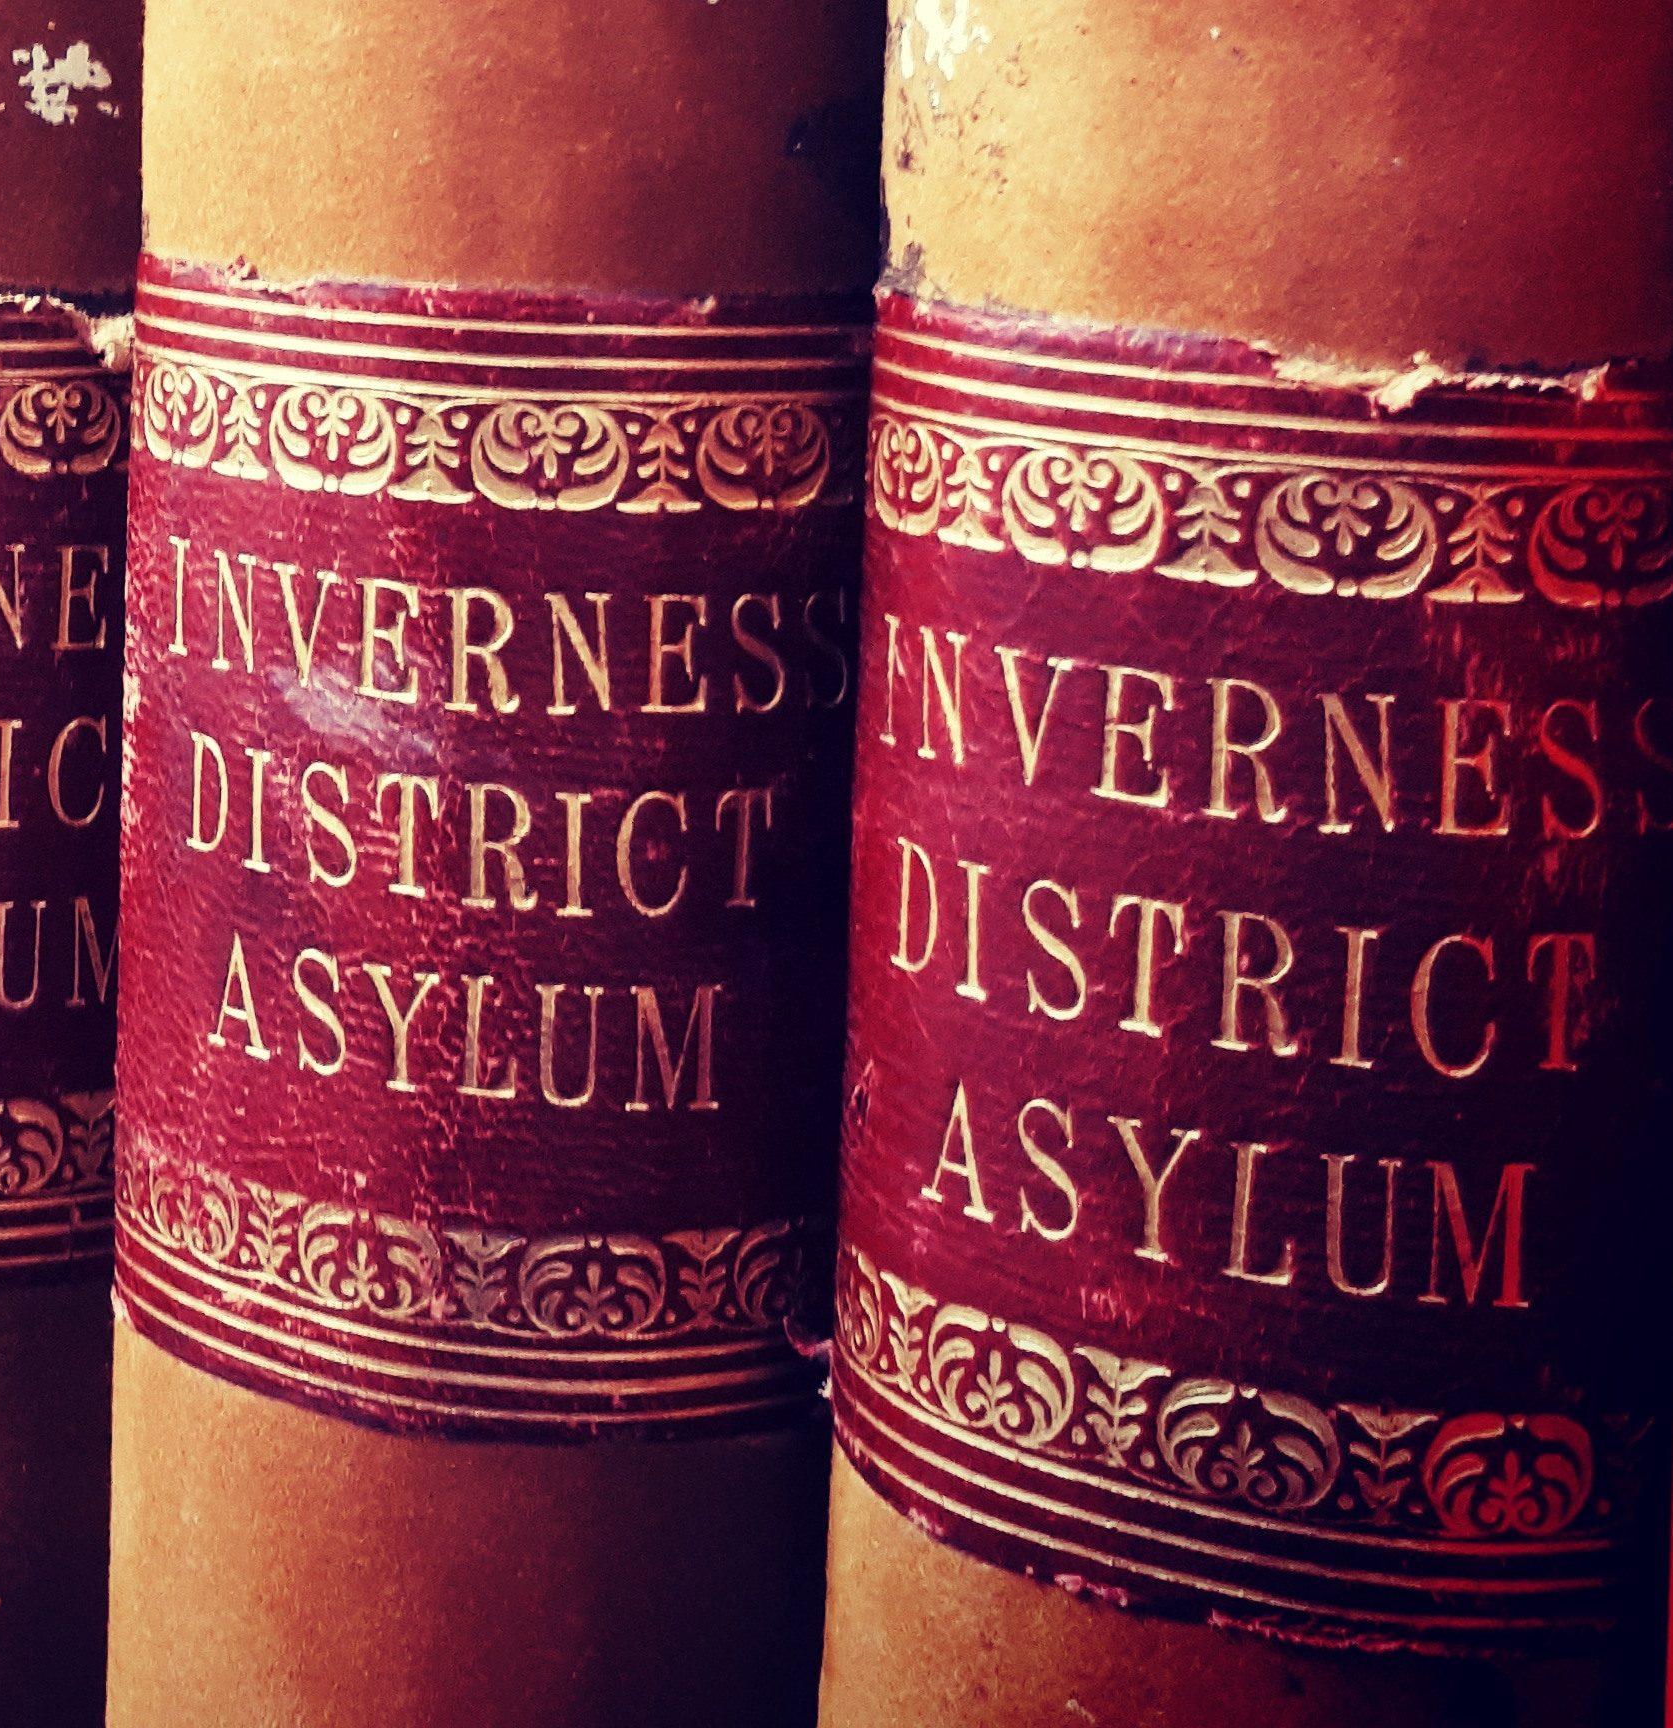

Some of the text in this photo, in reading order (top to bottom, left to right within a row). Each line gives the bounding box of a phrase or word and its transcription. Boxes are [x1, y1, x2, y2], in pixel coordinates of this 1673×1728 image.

[166, 534, 849, 718] INVERNESS
[185, 730, 773, 920] DISTRICT
[207, 929, 726, 1113] ASYLUM
[889, 834, 1598, 1080] DISTRICT
[918, 1077, 1538, 1310] ASYLUM
